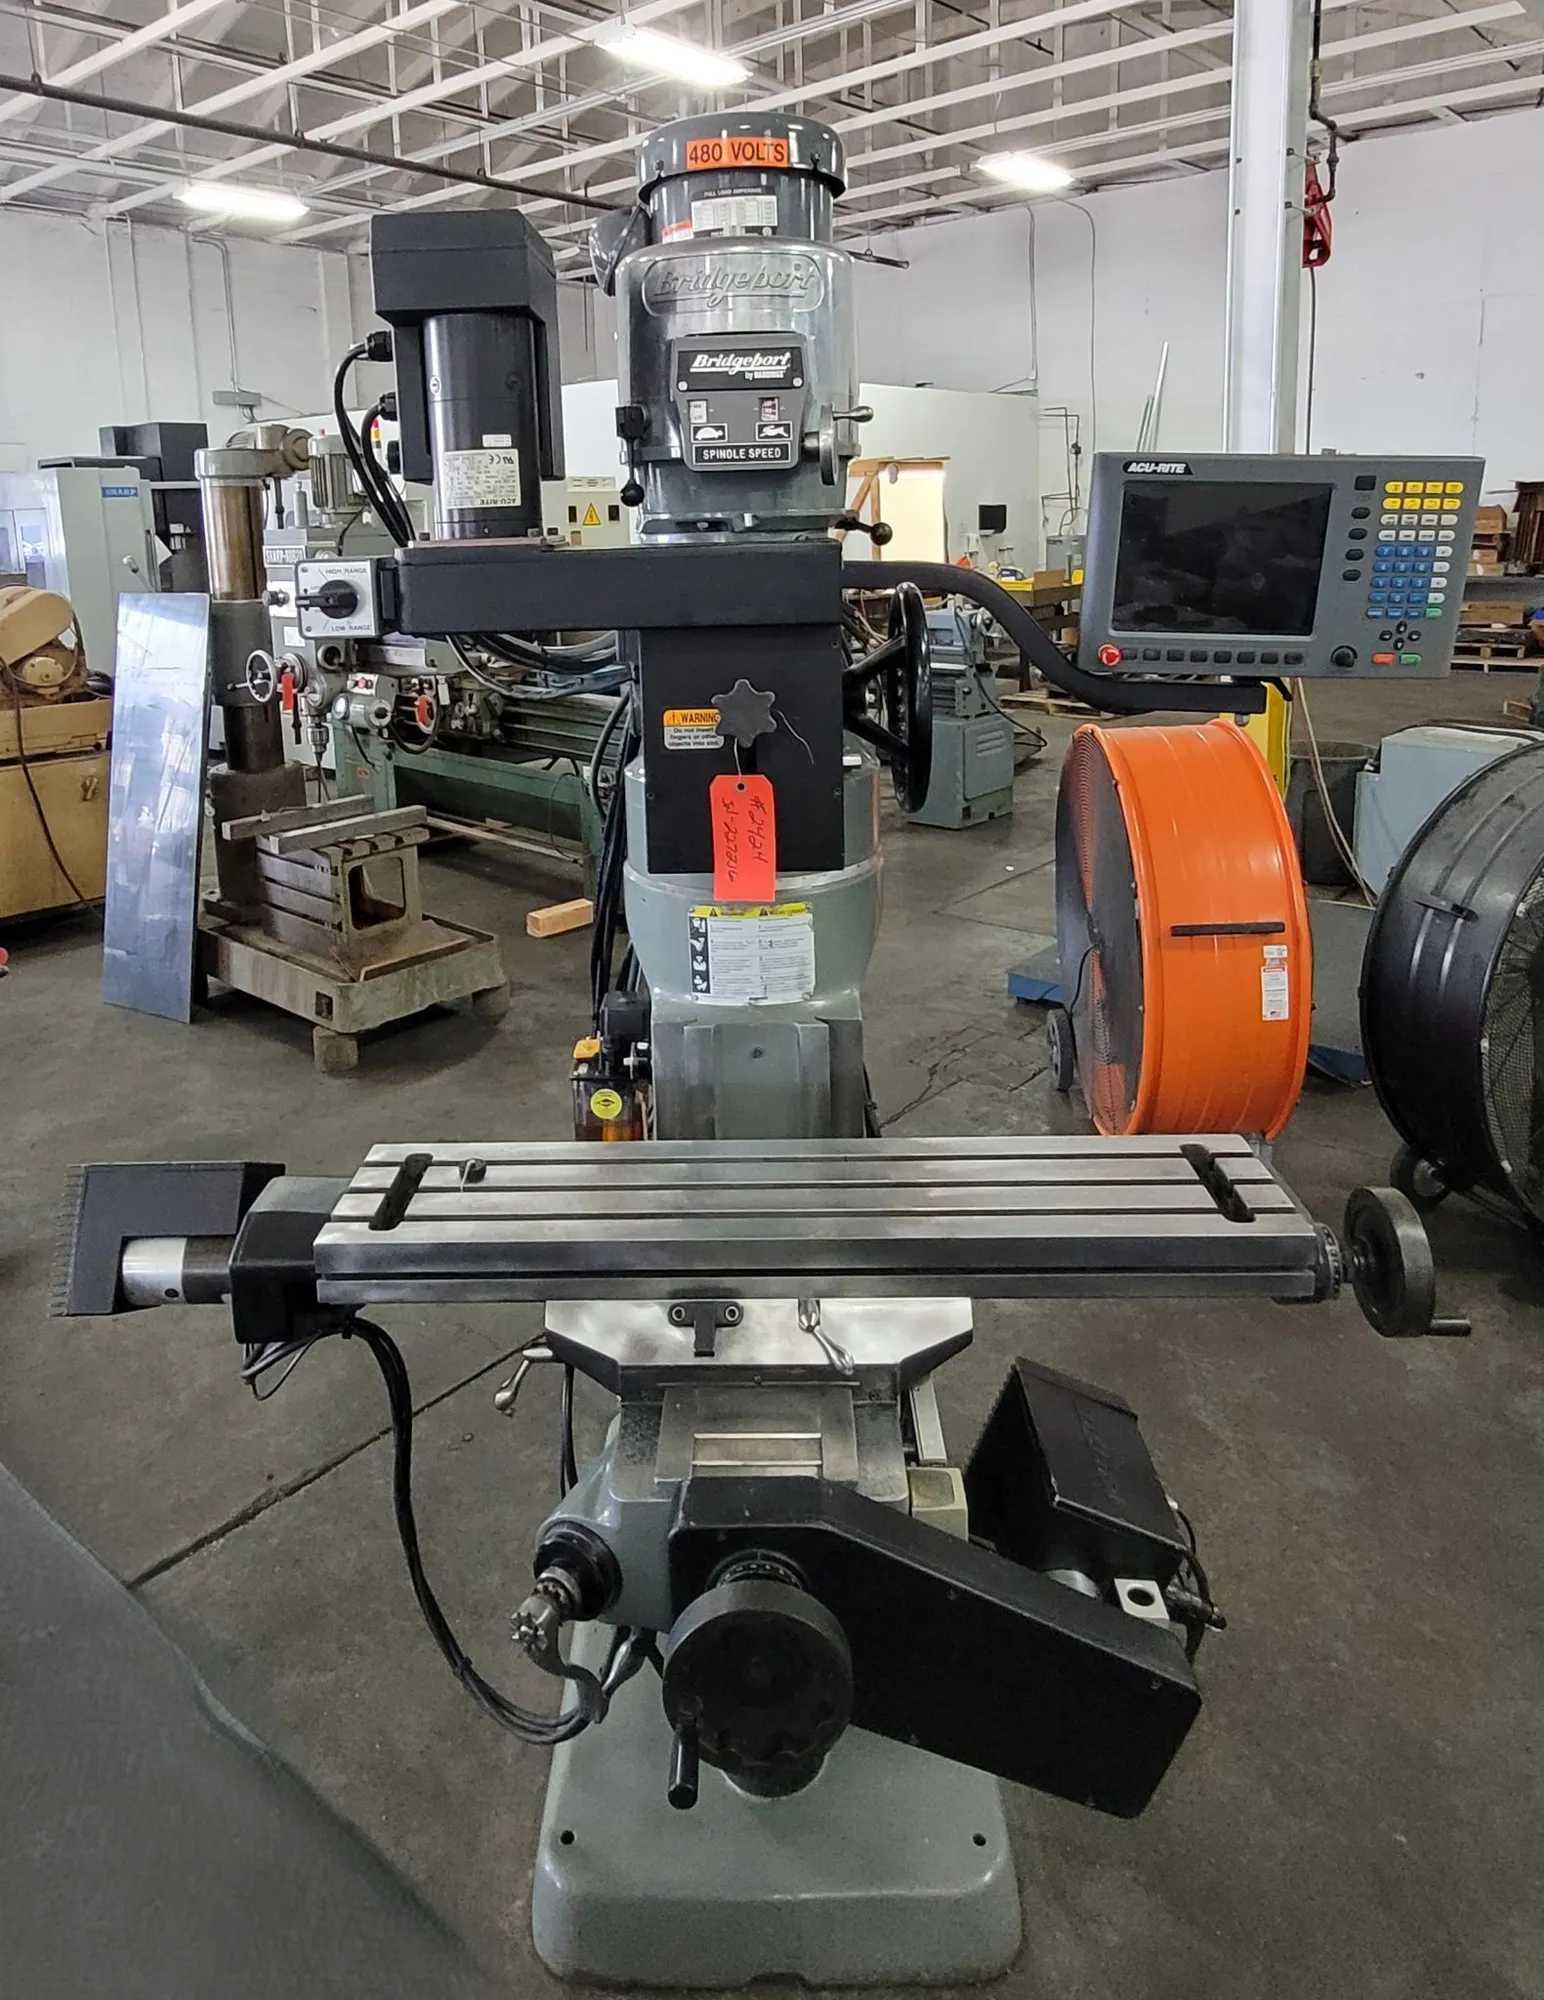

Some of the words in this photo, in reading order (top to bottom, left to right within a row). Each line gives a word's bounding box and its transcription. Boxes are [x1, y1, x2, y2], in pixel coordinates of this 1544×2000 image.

[689, 143, 723, 164] 480
[731, 142, 785, 163] VOLTS
[653, 263, 817, 307] Bridgeport
[690, 352, 792, 375] Bridgeport
[702, 448, 747, 460] SPINDLE
[748, 447, 782, 459] SPEED
[1127, 462, 1187, 474] ACU-RITE
